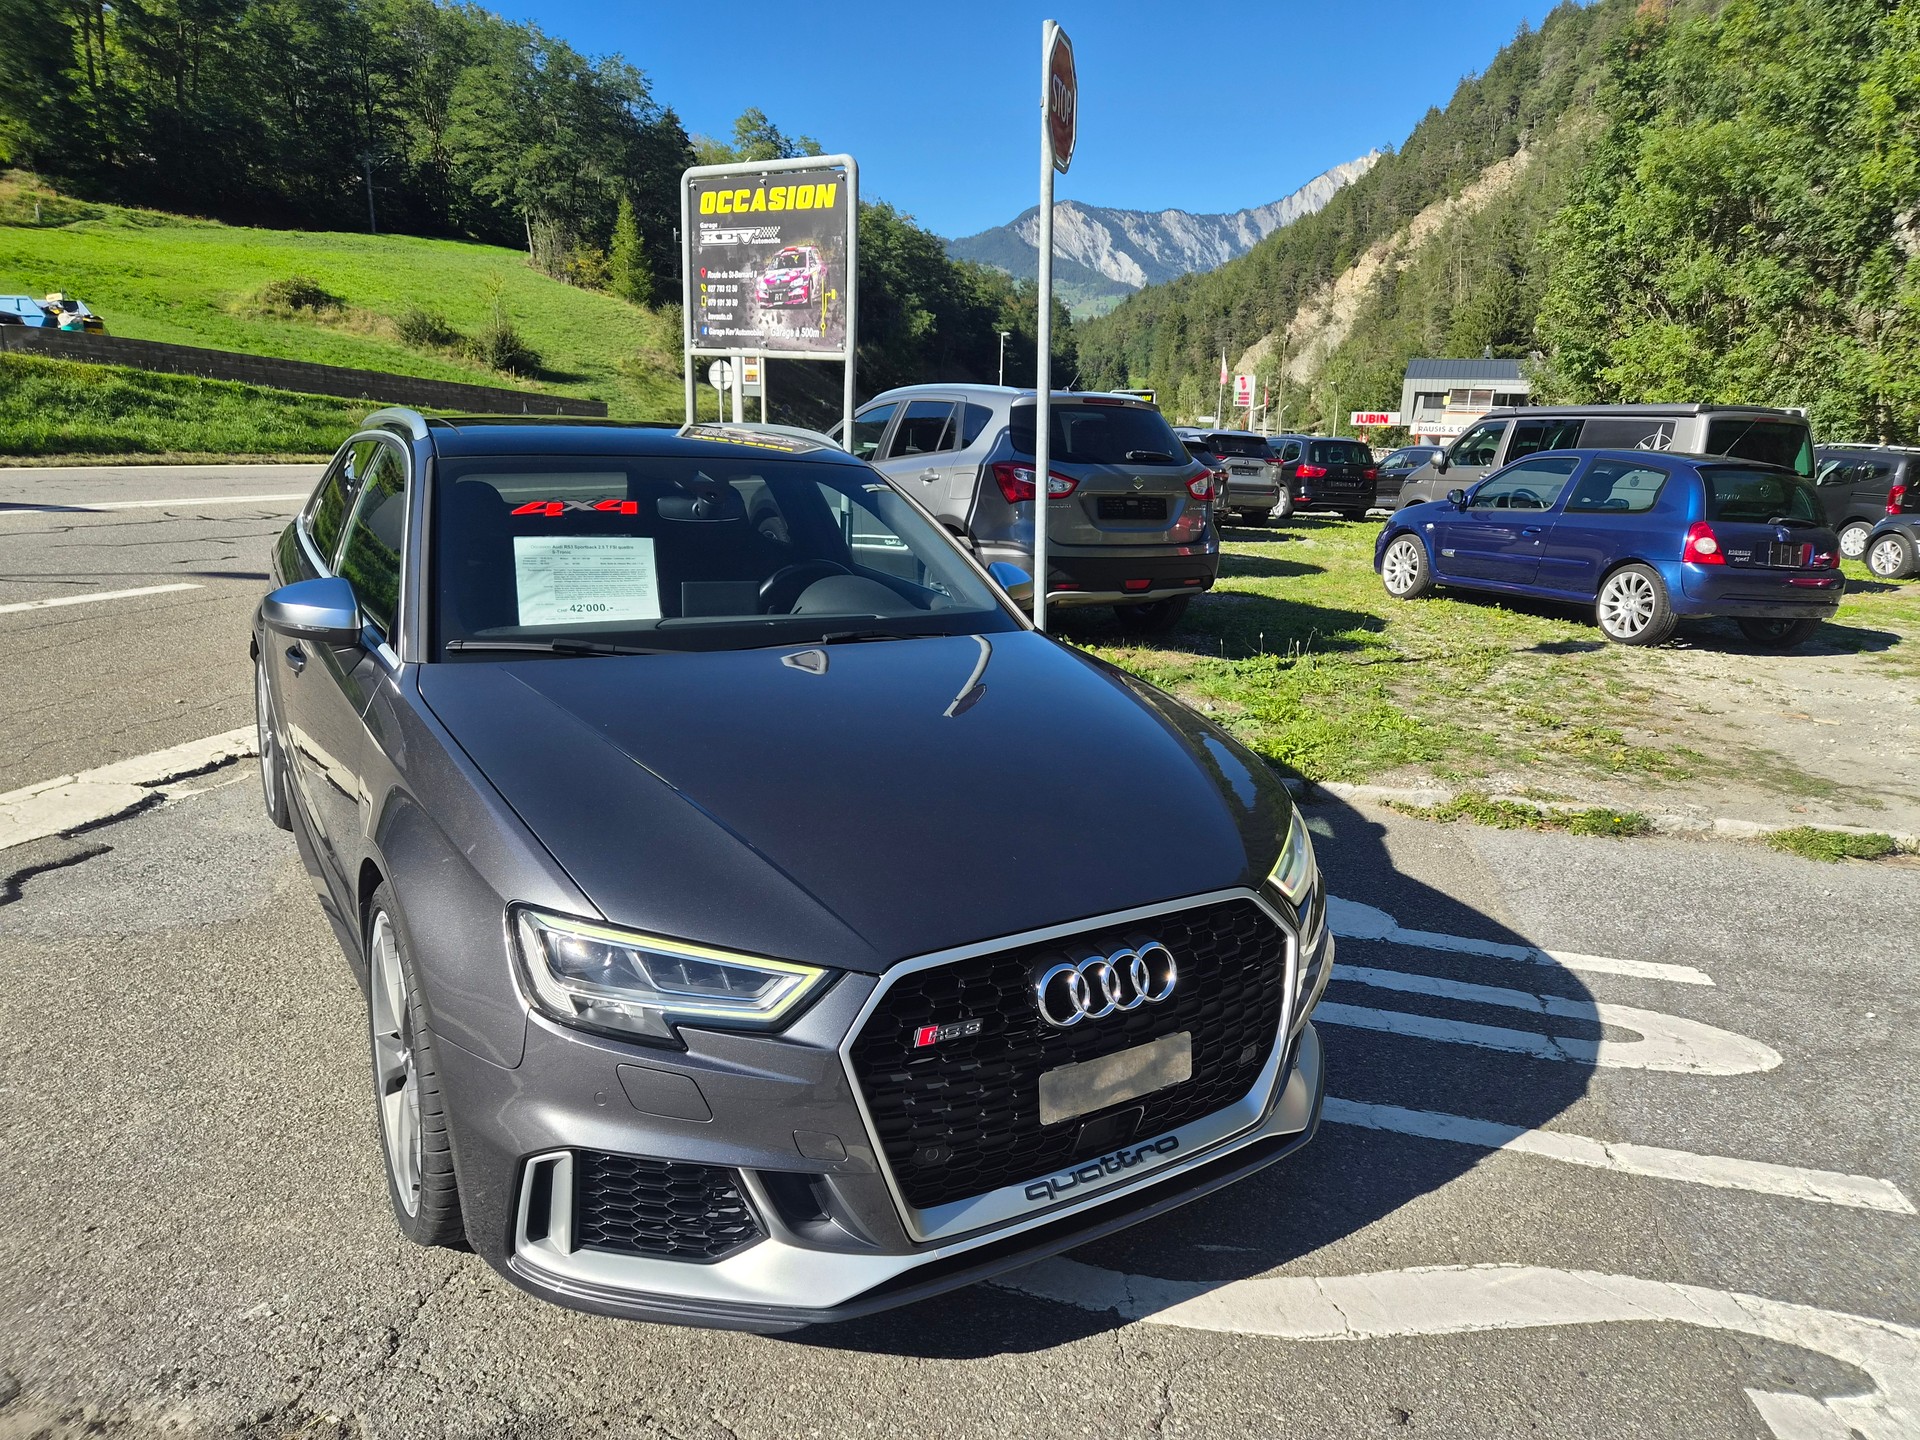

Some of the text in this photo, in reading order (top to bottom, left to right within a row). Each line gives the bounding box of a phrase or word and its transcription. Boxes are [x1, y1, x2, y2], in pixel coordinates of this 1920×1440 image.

[1052, 73, 1073, 126] STOP
[699, 183, 837, 215] OCCASION
[707, 271, 721, 279] Route
[722, 271, 728, 279] du
[709, 328, 725, 337] Garage
[770, 327, 820, 339] Garage à 500m
[1356, 414, 1389, 424] JUBIN
[569, 603, 614, 613] 42'000.-
[1024, 1135, 1179, 1201] quattro
